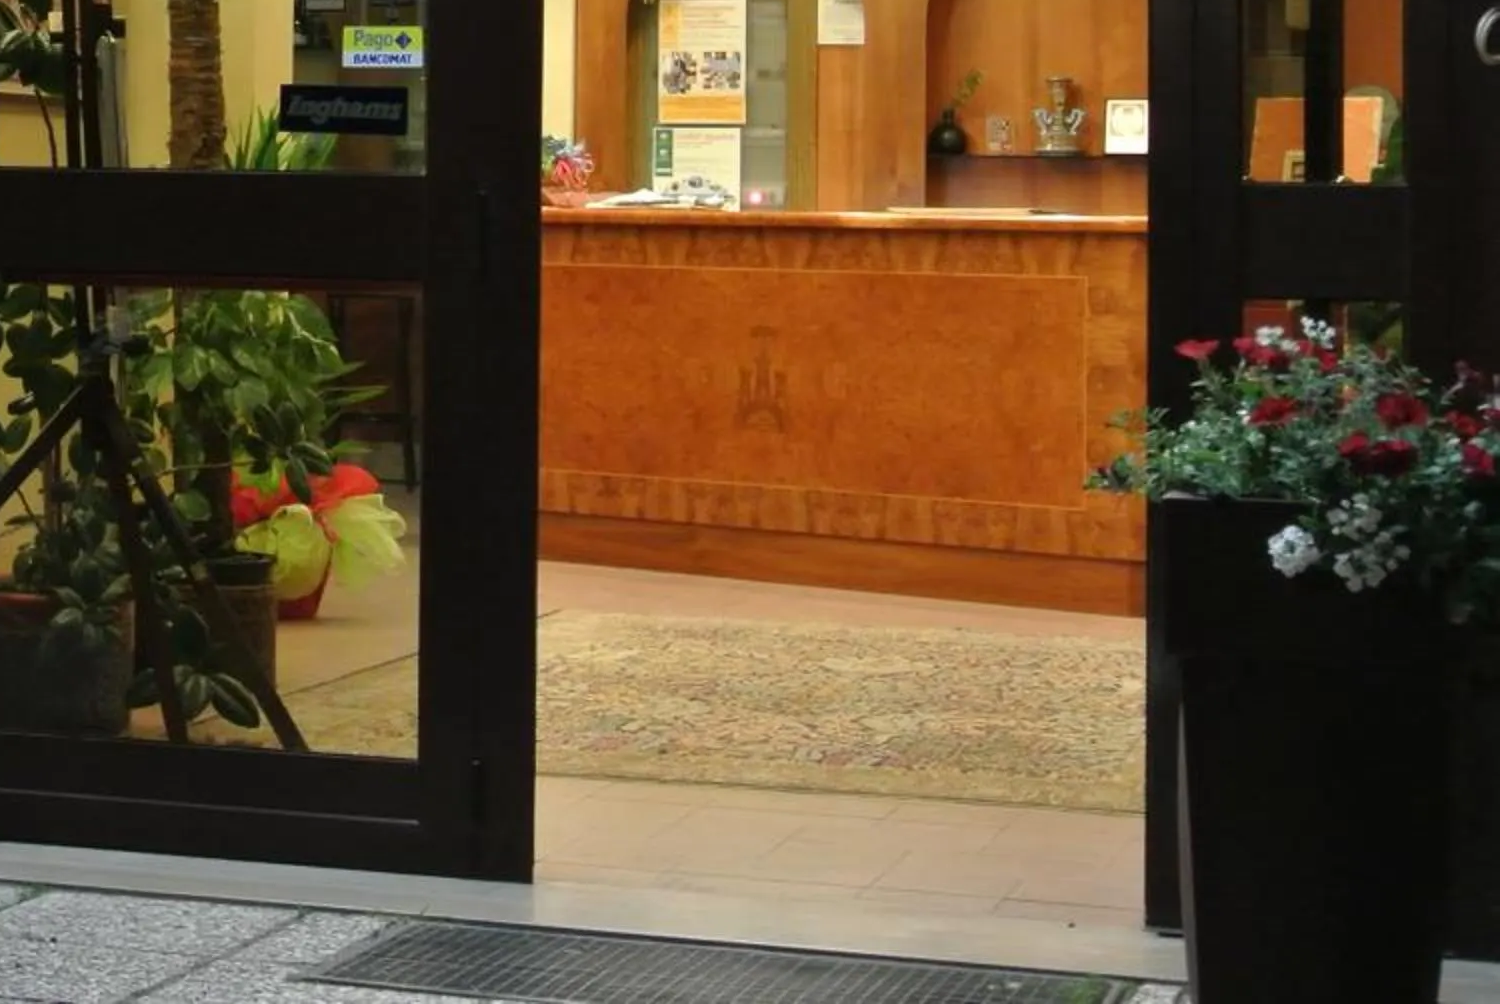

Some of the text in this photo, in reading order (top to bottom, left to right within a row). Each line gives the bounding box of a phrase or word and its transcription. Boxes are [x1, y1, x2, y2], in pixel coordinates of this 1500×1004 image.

[353, 29, 394, 51] Pago
[353, 53, 413, 65] BANCOMAT
[287, 94, 403, 125] Inghams
